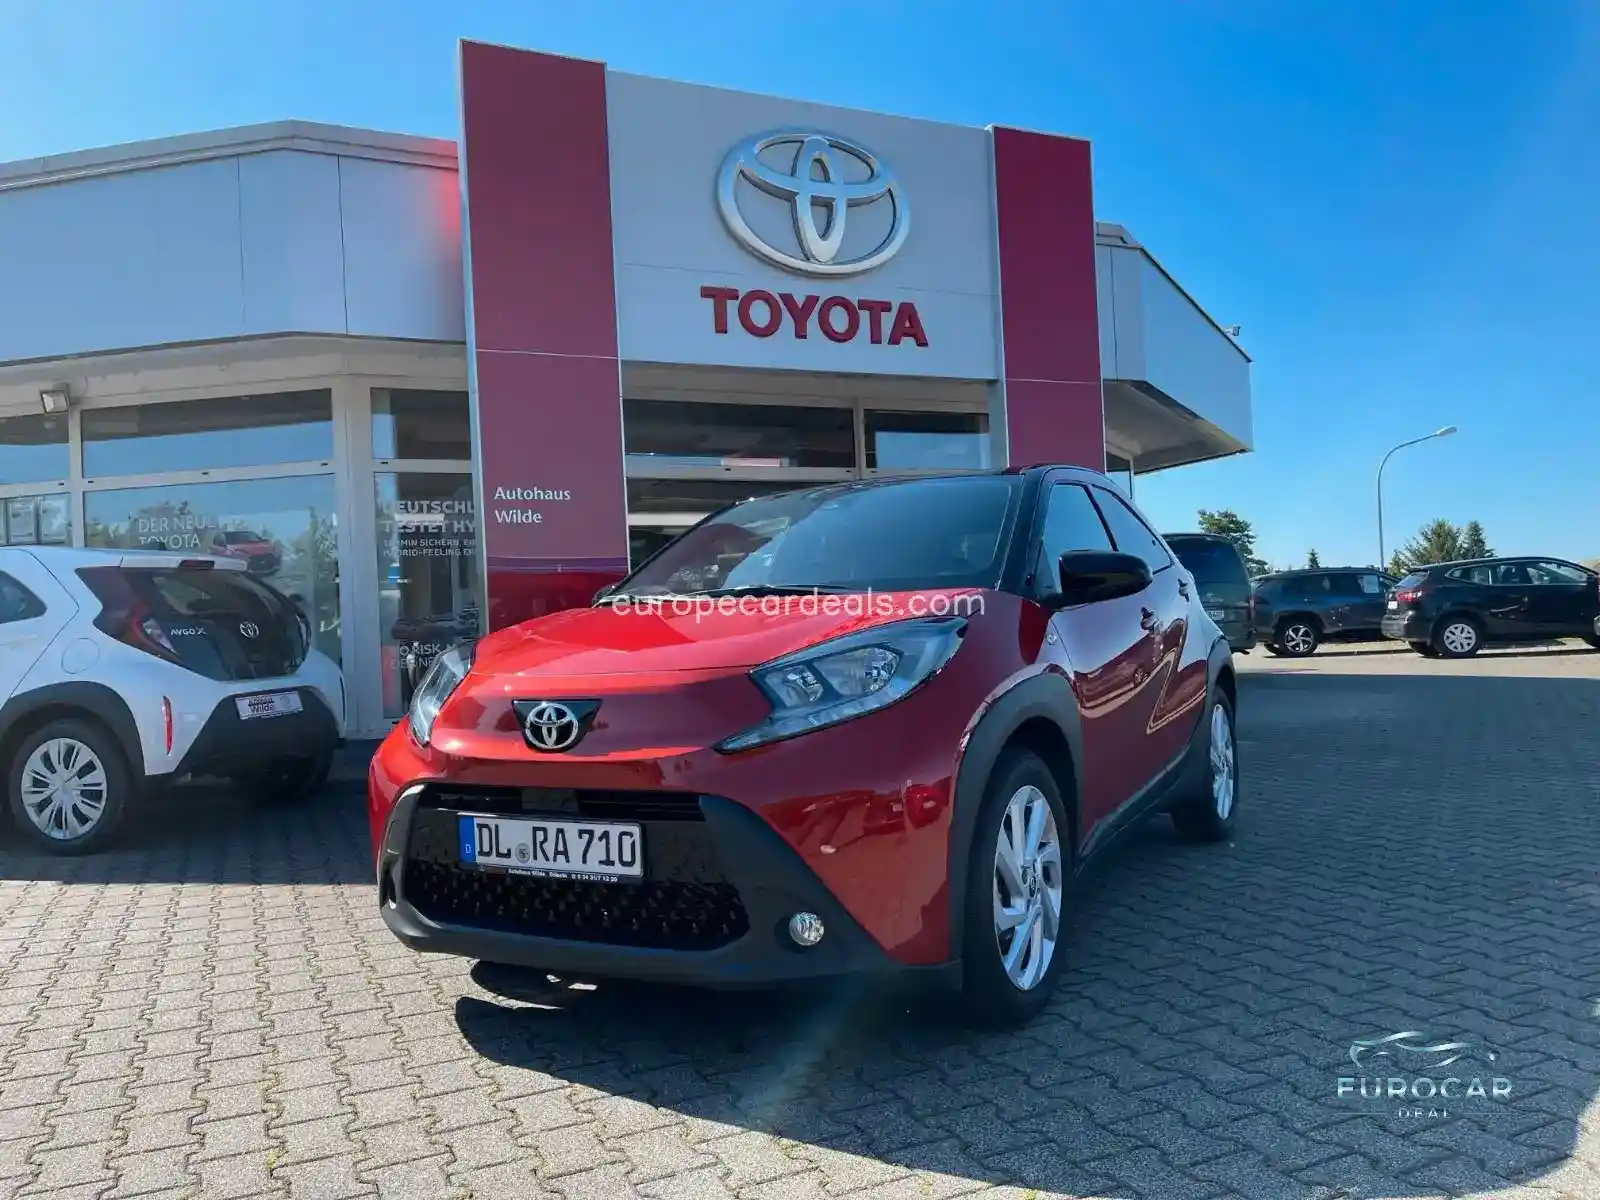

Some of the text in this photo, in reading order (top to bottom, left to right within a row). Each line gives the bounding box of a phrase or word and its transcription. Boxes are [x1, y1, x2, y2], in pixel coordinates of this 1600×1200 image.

[700, 285, 929, 347] TOYOTA
[494, 486, 571, 501] Autohaus
[383, 500, 474, 514] EUTSCHL
[494, 508, 542, 524] Wilde
[138, 517, 168, 533] DER
[465, 823, 636, 868] D DL RA 710
